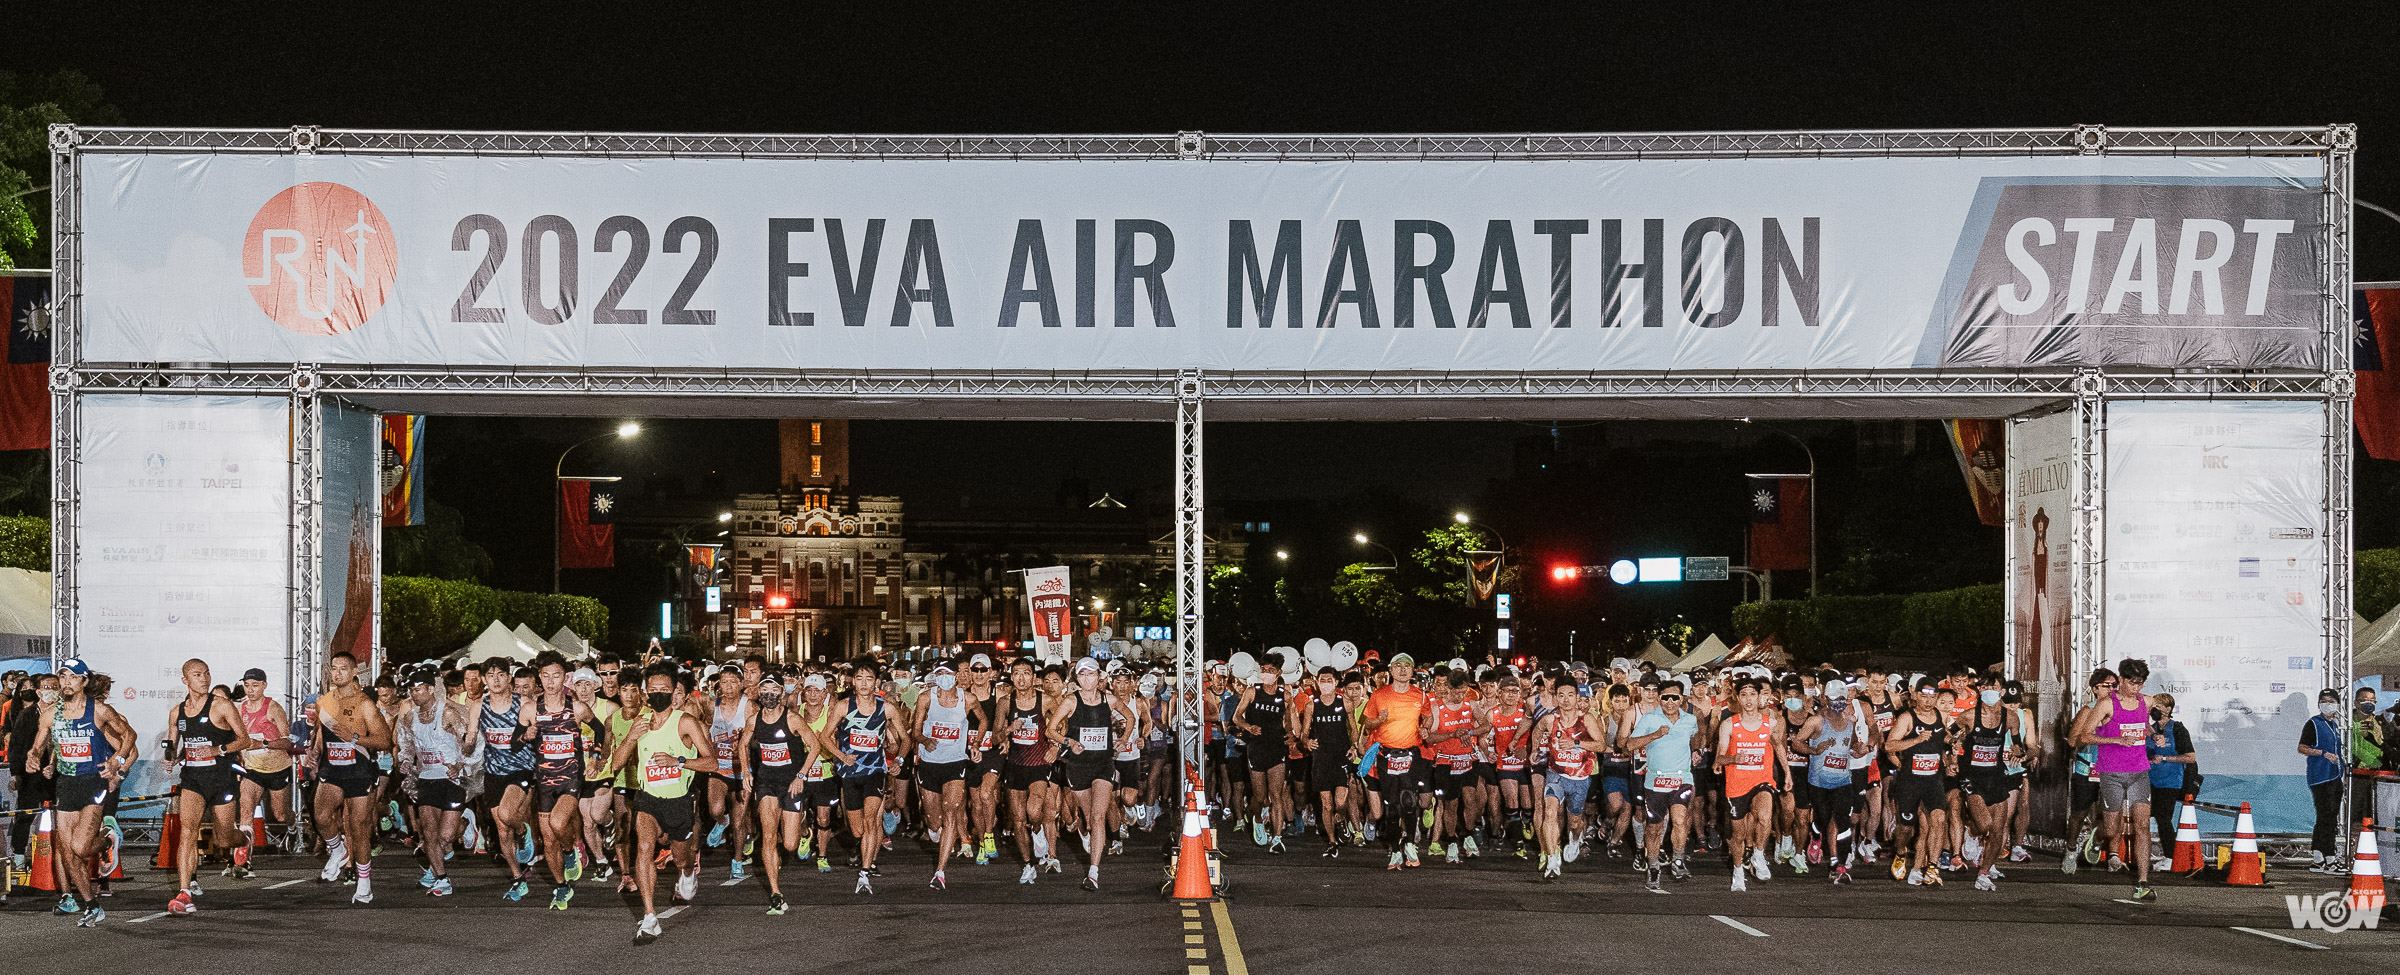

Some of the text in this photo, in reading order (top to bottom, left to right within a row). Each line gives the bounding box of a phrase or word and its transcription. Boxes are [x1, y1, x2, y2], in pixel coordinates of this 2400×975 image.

[451, 214, 1821, 328] 2022 EVA AIR MARATHON
[1997, 217, 2295, 315] START
[2202, 455, 2229, 469] NRC
[201, 478, 242, 488] TAIPEI
[2183, 655, 2216, 669] meiji
[1255, 703, 1280, 713] PACER
[63, 746, 88, 754] 10780
[649, 766, 679, 778] 04413
